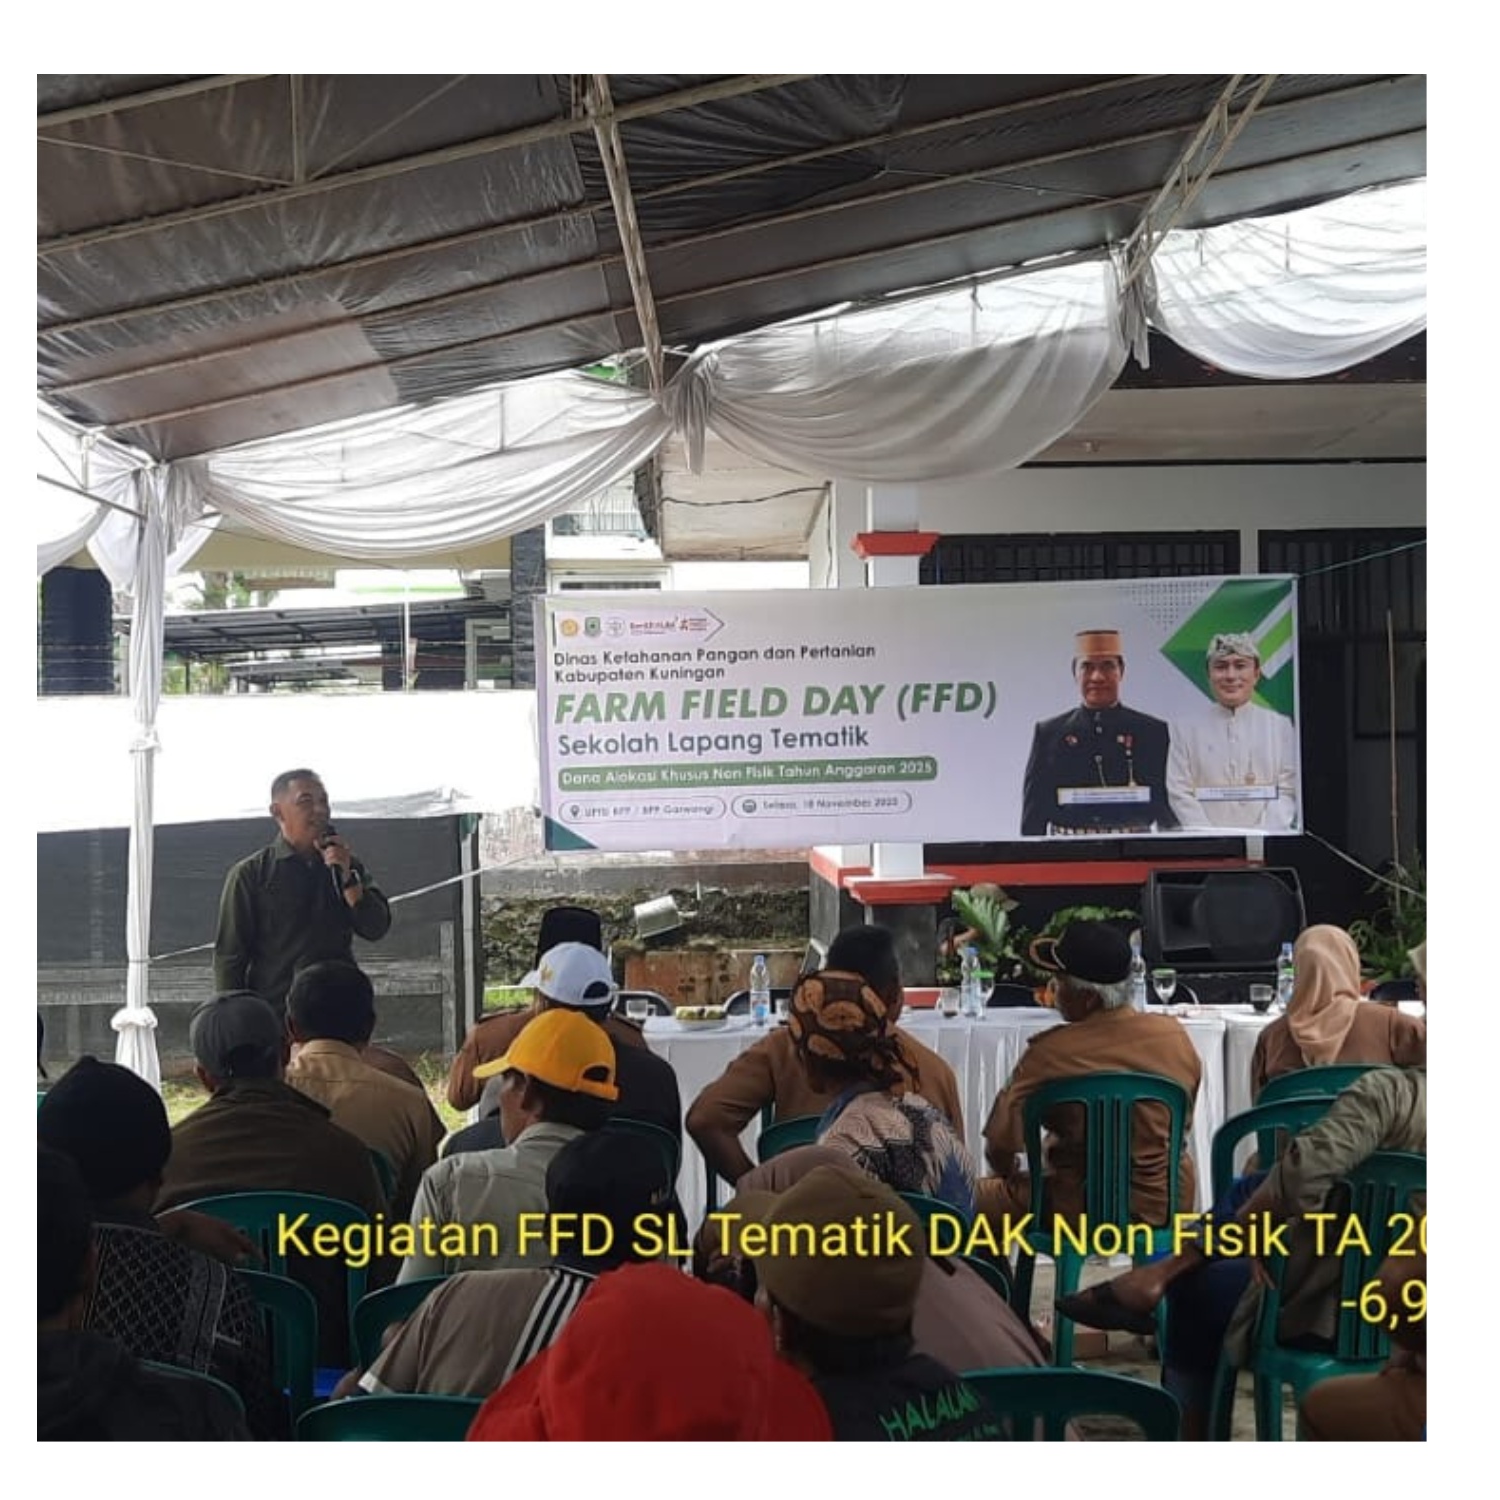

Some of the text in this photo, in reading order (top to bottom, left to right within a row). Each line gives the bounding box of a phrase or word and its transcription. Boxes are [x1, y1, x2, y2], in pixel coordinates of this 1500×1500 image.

[554, 643, 876, 667] Dinas Ketahanan Pangan dan Pertanian
[554, 665, 725, 685] Kabupaten Kuningan
[555, 680, 998, 725] FARM FIELD DAY (FFD)
[559, 725, 870, 756] Sekolah Lapang Tematik
[562, 761, 933, 786] Dana Alokasi Khusus Non Fisik Tahun Anggaran 2025
